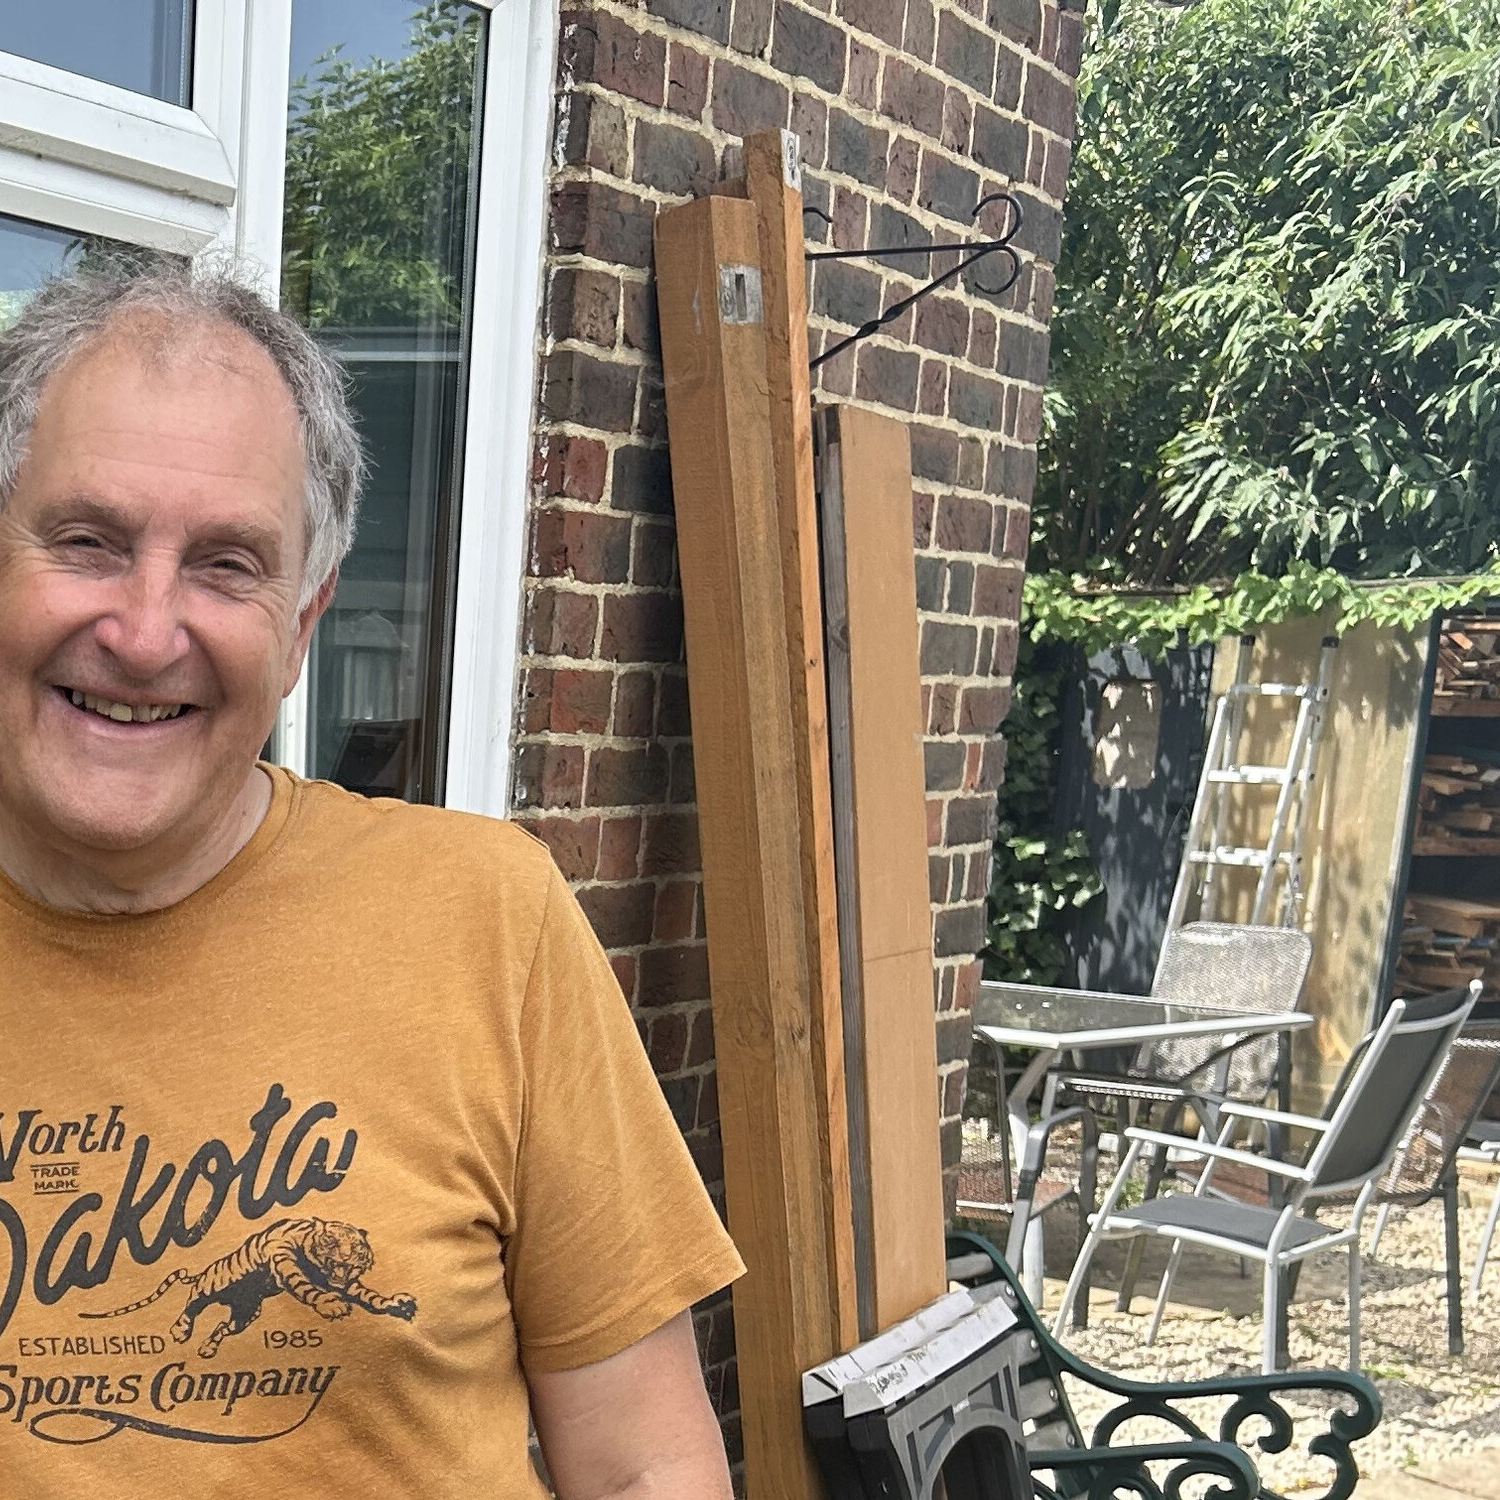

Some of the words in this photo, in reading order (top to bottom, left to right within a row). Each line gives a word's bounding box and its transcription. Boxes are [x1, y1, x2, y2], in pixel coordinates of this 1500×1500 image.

[30, 1166, 80, 1178] TRADE
[34, 1179, 80, 1190] MARK
[19, 1335, 166, 1356] ESTABLISHED
[263, 1329, 323, 1349] 1985
[150, 1361, 342, 1417] Company
